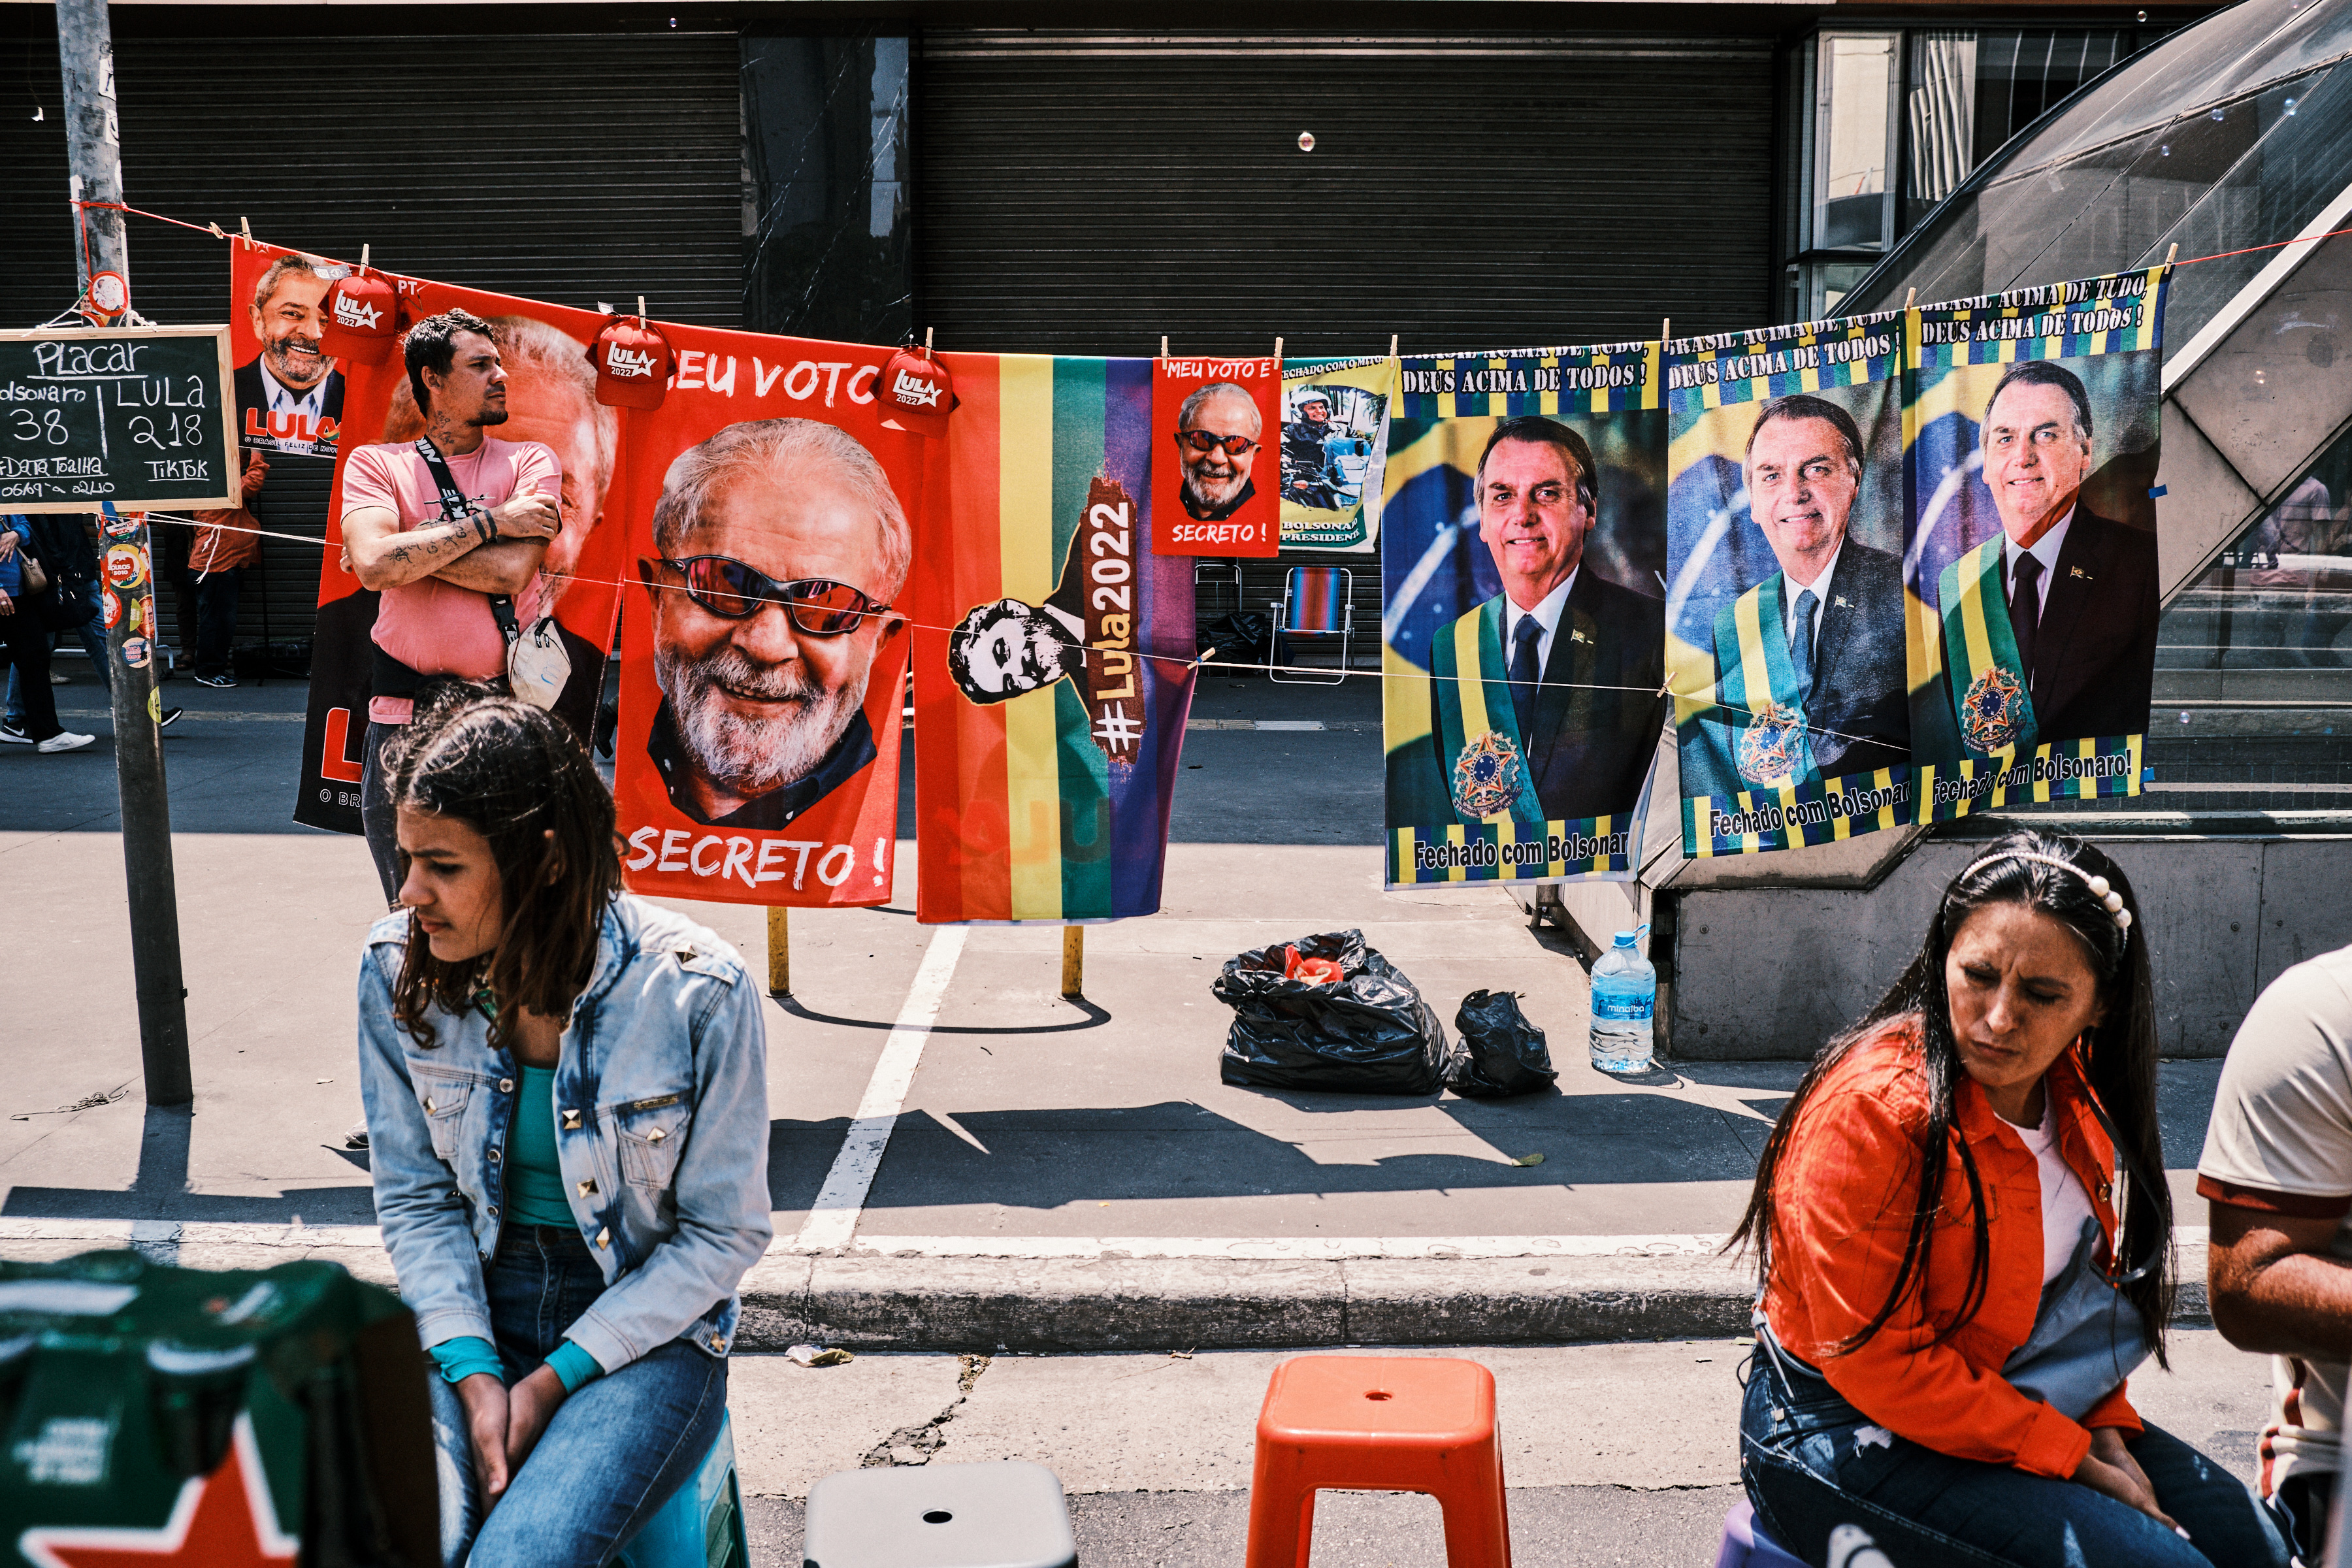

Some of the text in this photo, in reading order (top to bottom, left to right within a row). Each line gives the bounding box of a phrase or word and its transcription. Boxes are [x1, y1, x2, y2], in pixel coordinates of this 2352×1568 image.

[397, 280, 417, 295] PT
[1920, 276, 2148, 312] ASIL ACIMA DE TUDO,
[333, 289, 384, 330] LULA
[336, 315, 355, 327] 2022
[1742, 323, 1806, 346] ACIMA
[1921, 321, 1971, 344] DEUS
[1974, 317, 2036, 341] ACIMA
[2040, 314, 2066, 337] DE
[2072, 306, 2132, 334] TODOS
[606, 340, 657, 378] LULA
[610, 366, 632, 377] 2022
[1167, 357, 1271, 380] MEU VOTO É
[1282, 363, 1324, 380] ECHADO
[1325, 360, 1347, 373] COM
[1348, 359, 1356, 368] O
[1668, 361, 1718, 390] DEUS
[1724, 351, 1789, 381] ACIMA
[1792, 345, 1820, 370] DE
[1823, 334, 1891, 365] TODOS
[0, 381, 86, 402] olsonaro
[892, 368, 943, 408] LULA
[1401, 370, 1456, 393] DEUS
[1462, 370, 1528, 393] ACIMA
[1533, 368, 1561, 391] DE
[1567, 364, 1635, 389] TODOS
[896, 394, 917, 406] 2022
[10, 408, 203, 449] 38 218
[245, 407, 342, 446] LULA
[253, 437, 282, 446] BRASIL
[1171, 523, 1256, 544] SECRETO
[1281, 528, 1360, 542] PRESIDENTE
[1090, 501, 1143, 753] #Lula2022
[1932, 749, 2132, 806] Fechado com Bolsonaro!
[319, 789, 331, 802] O
[1709, 802, 1783, 838] Fechado
[1785, 800, 1827, 828] com
[626, 825, 856, 890] SECRETO
[1413, 832, 1629, 870] Fechado com Bolsonar
[1607, 1005, 1644, 1013] minalba
